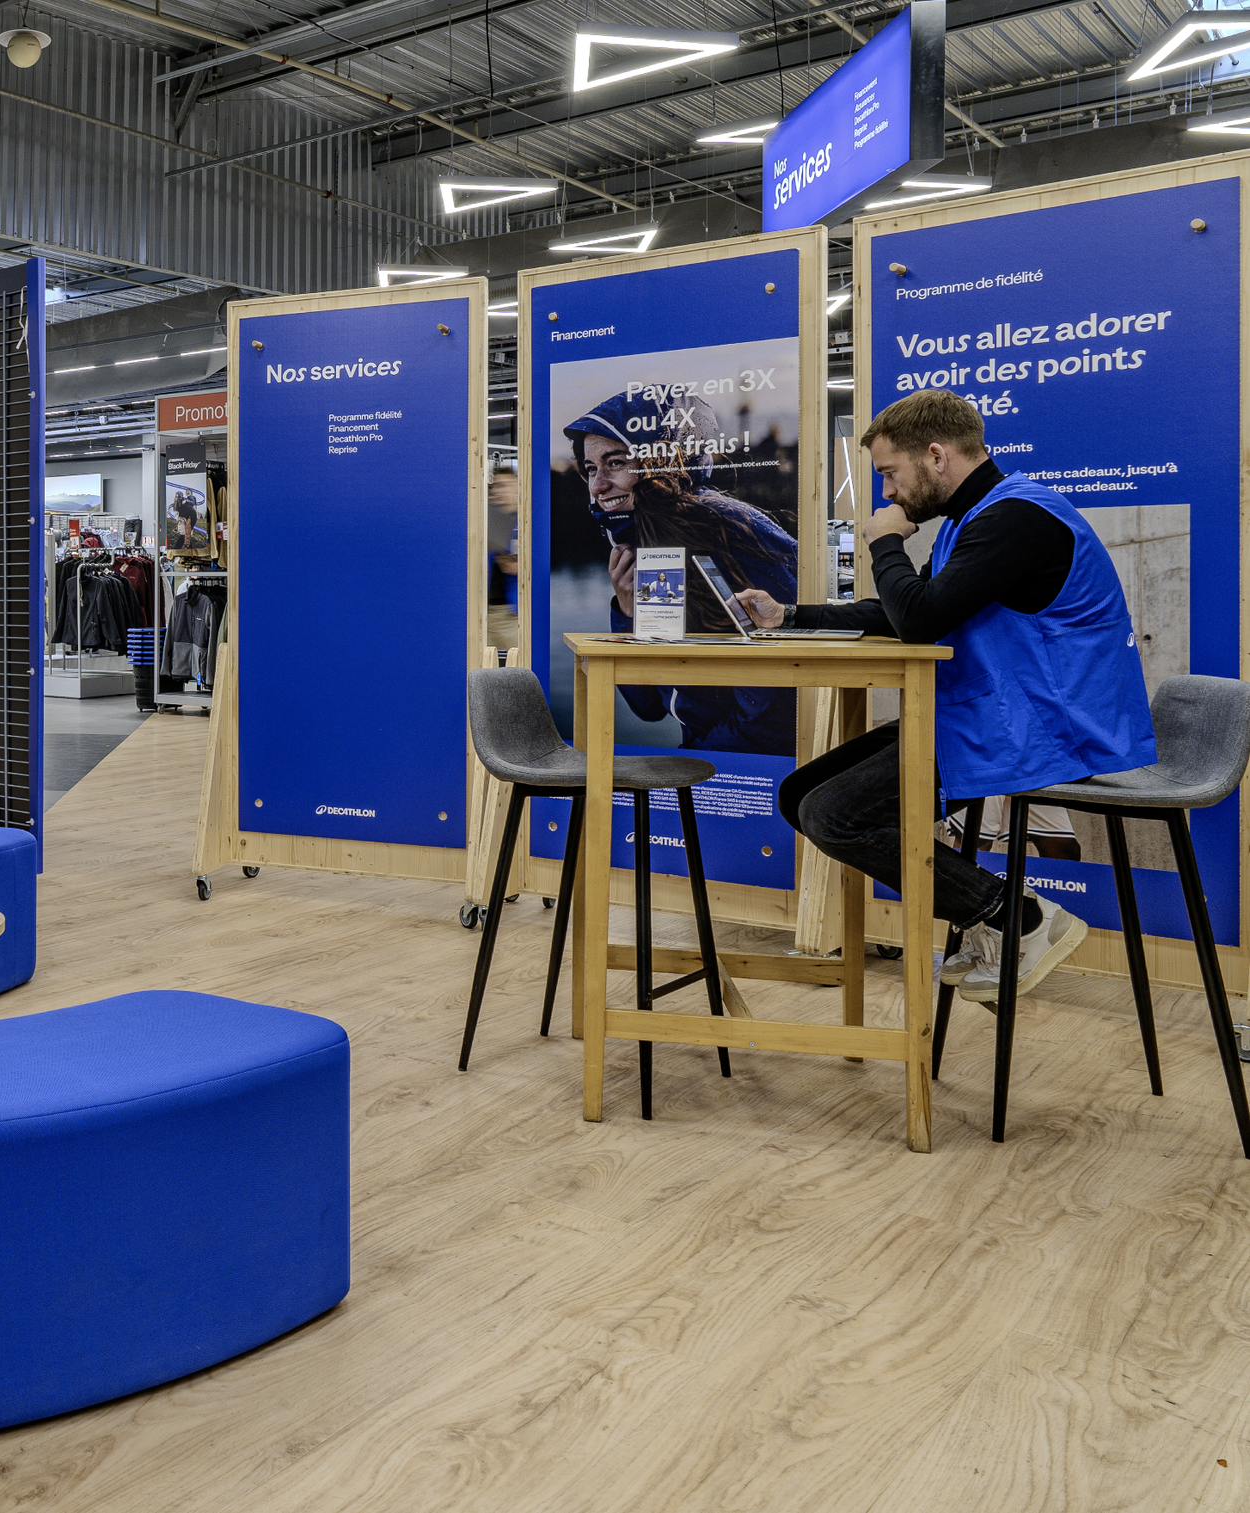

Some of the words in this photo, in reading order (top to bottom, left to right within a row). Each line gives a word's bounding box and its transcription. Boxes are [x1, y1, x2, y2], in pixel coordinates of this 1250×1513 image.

[854, 76, 878, 101] Financement
[854, 130, 875, 150] Programme
[774, 157, 788, 179] Nos
[774, 142, 832, 210] services
[896, 279, 974, 300] Programme
[976, 276, 994, 290] de
[996, 269, 1043, 288] fidélité
[551, 326, 615, 342] Financement
[896, 332, 971, 358] Vous
[976, 322, 1050, 350] allez
[1055, 310, 1172, 342] adorer
[266, 364, 307, 384] Nos
[310, 358, 402, 380] services
[896, 362, 970, 391] avoir
[976, 358, 1032, 384] des
[1038, 348, 1146, 383] points
[626, 381, 698, 404] Payez
[702, 377, 734, 396] en
[739, 368, 776, 392] 3X
[965, 390, 1019, 416] ôté.
[328, 413, 374, 424] Programme
[375, 410, 402, 420] fidélité
[626, 416, 657, 433] ou
[660, 407, 696, 430] 4X
[328, 423, 379, 432] Financement
[328, 434, 368, 444] Decathlon
[370, 434, 383, 442] Pro
[626, 440, 681, 460] sans
[684, 432, 739, 456] frais
[744, 431, 750, 452] !
[993, 442, 1033, 455] points
[328, 446, 358, 456] Reprise
[1063, 466, 1126, 479] cadeaux,
[1126, 462, 1178, 478] jusqu'à
[1075, 481, 1138, 492] cadeaux.
[328, 806, 376, 818] DECATHLON
[649, 835, 686, 847] ECATHLO
[1023, 876, 1086, 893] ECATHLON
